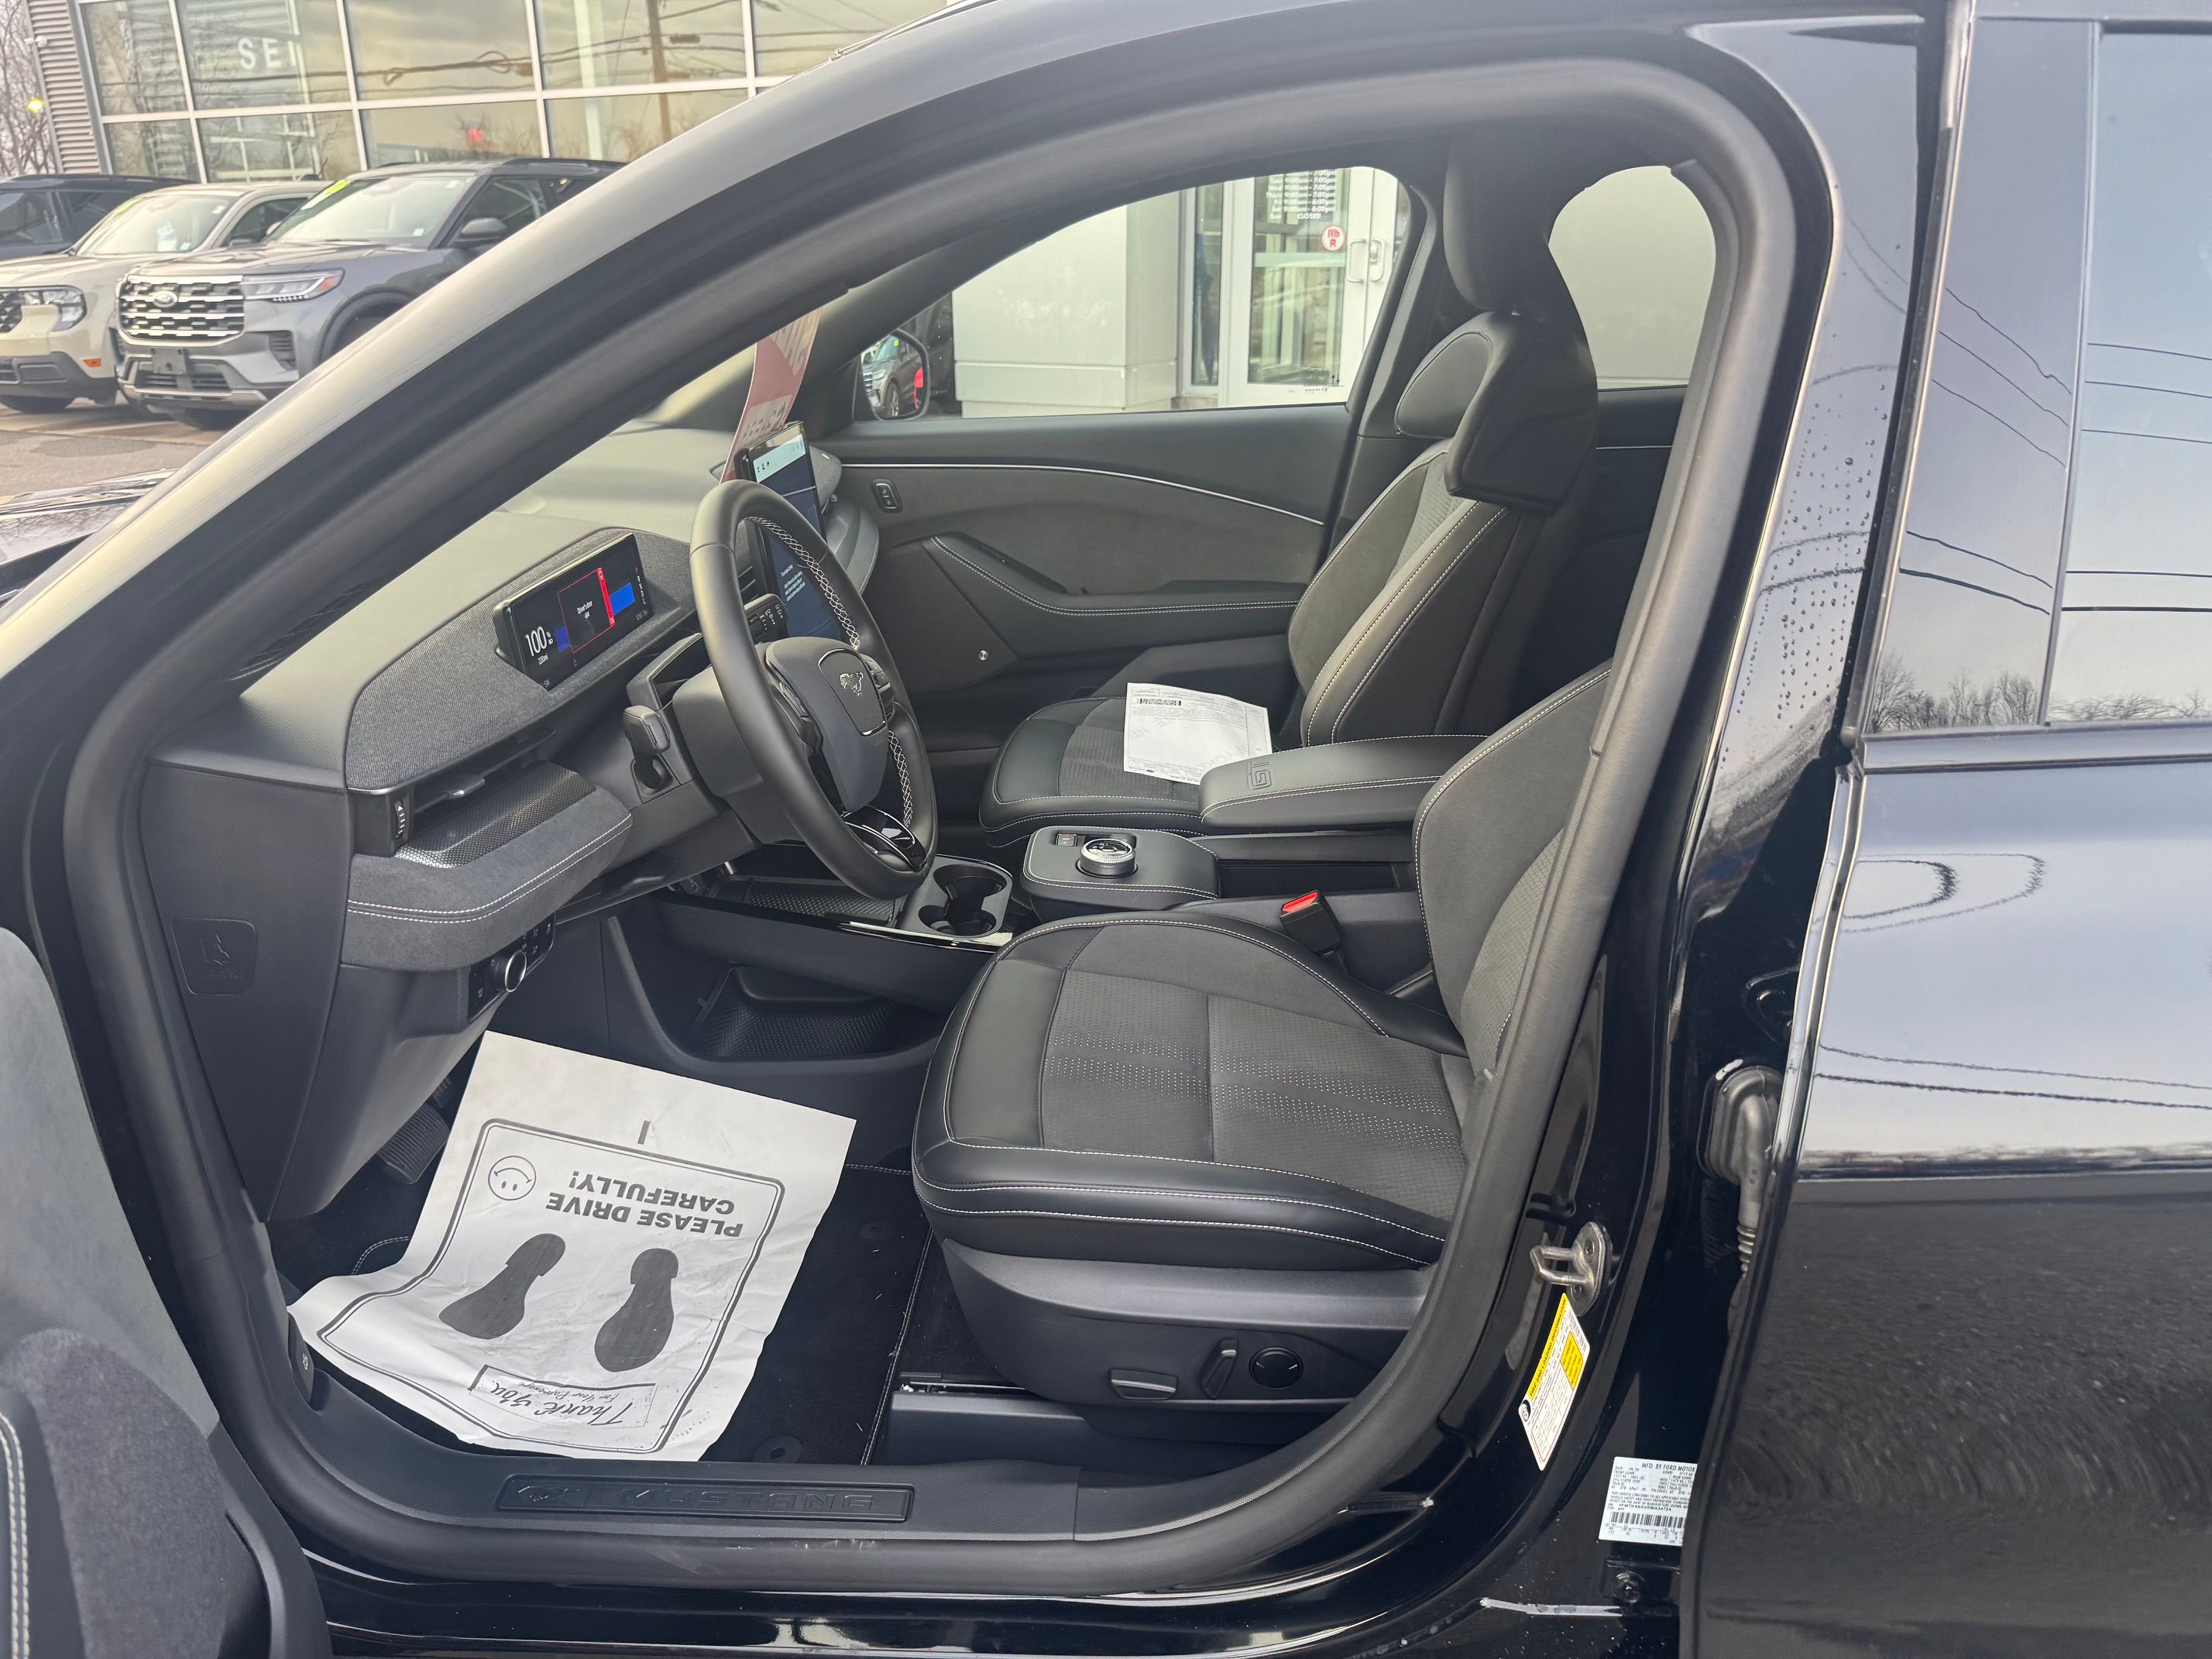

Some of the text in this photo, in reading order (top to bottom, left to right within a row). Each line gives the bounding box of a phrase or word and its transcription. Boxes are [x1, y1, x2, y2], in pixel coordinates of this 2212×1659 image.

[525, 626, 548, 657] 100
[568, 1171, 735, 1215] CAREFULLY!
[545, 1192, 744, 1238] PLEASE DRIVE
[534, 1401, 634, 1426] Thank
[620, 1489, 874, 1511] MUSTANG
